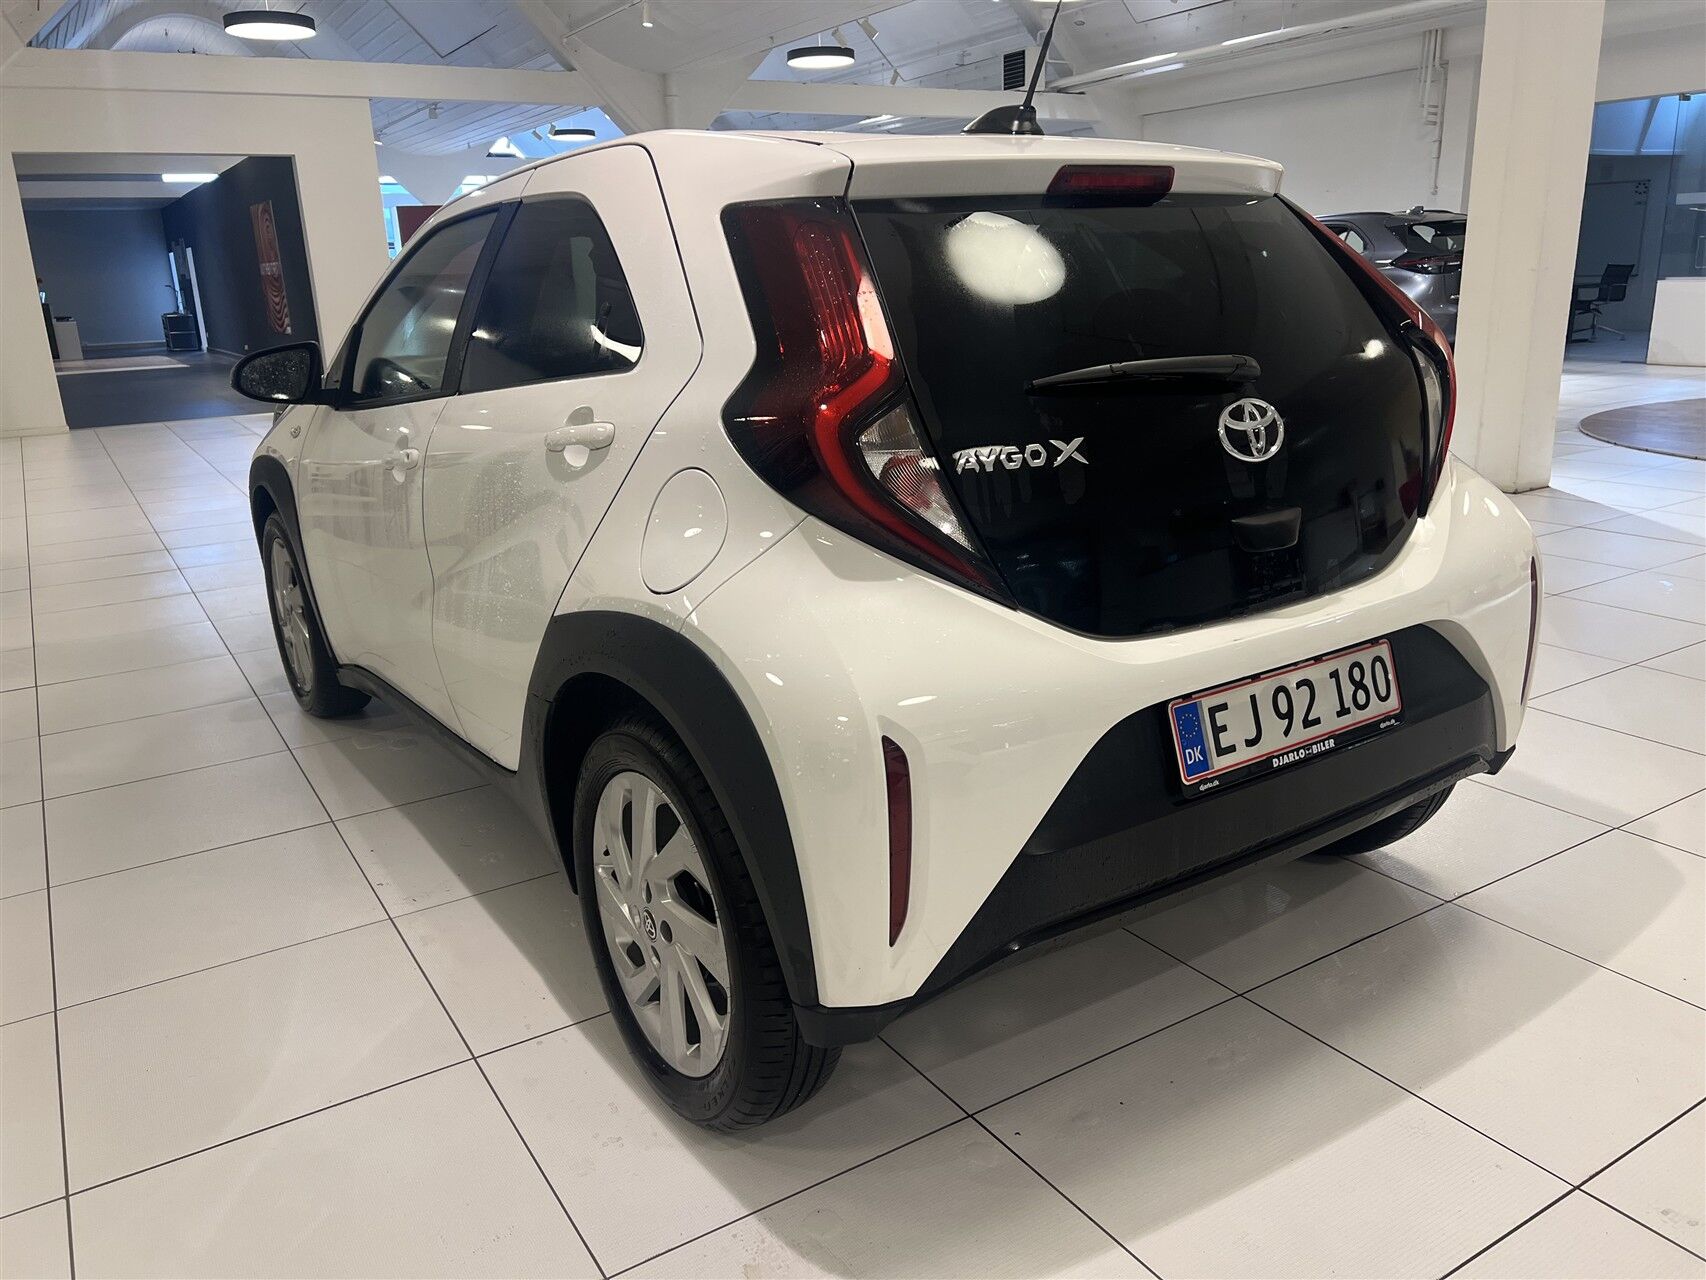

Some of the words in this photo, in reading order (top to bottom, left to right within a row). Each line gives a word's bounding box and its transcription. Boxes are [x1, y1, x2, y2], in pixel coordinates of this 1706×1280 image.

[1207, 694, 1263, 758] EJ
[1271, 678, 1322, 738] 92
[1329, 655, 1392, 718] 180
[1185, 745, 1204, 765] DK
[1272, 748, 1306, 768] DJARLO
[1312, 738, 1336, 754] BILER
